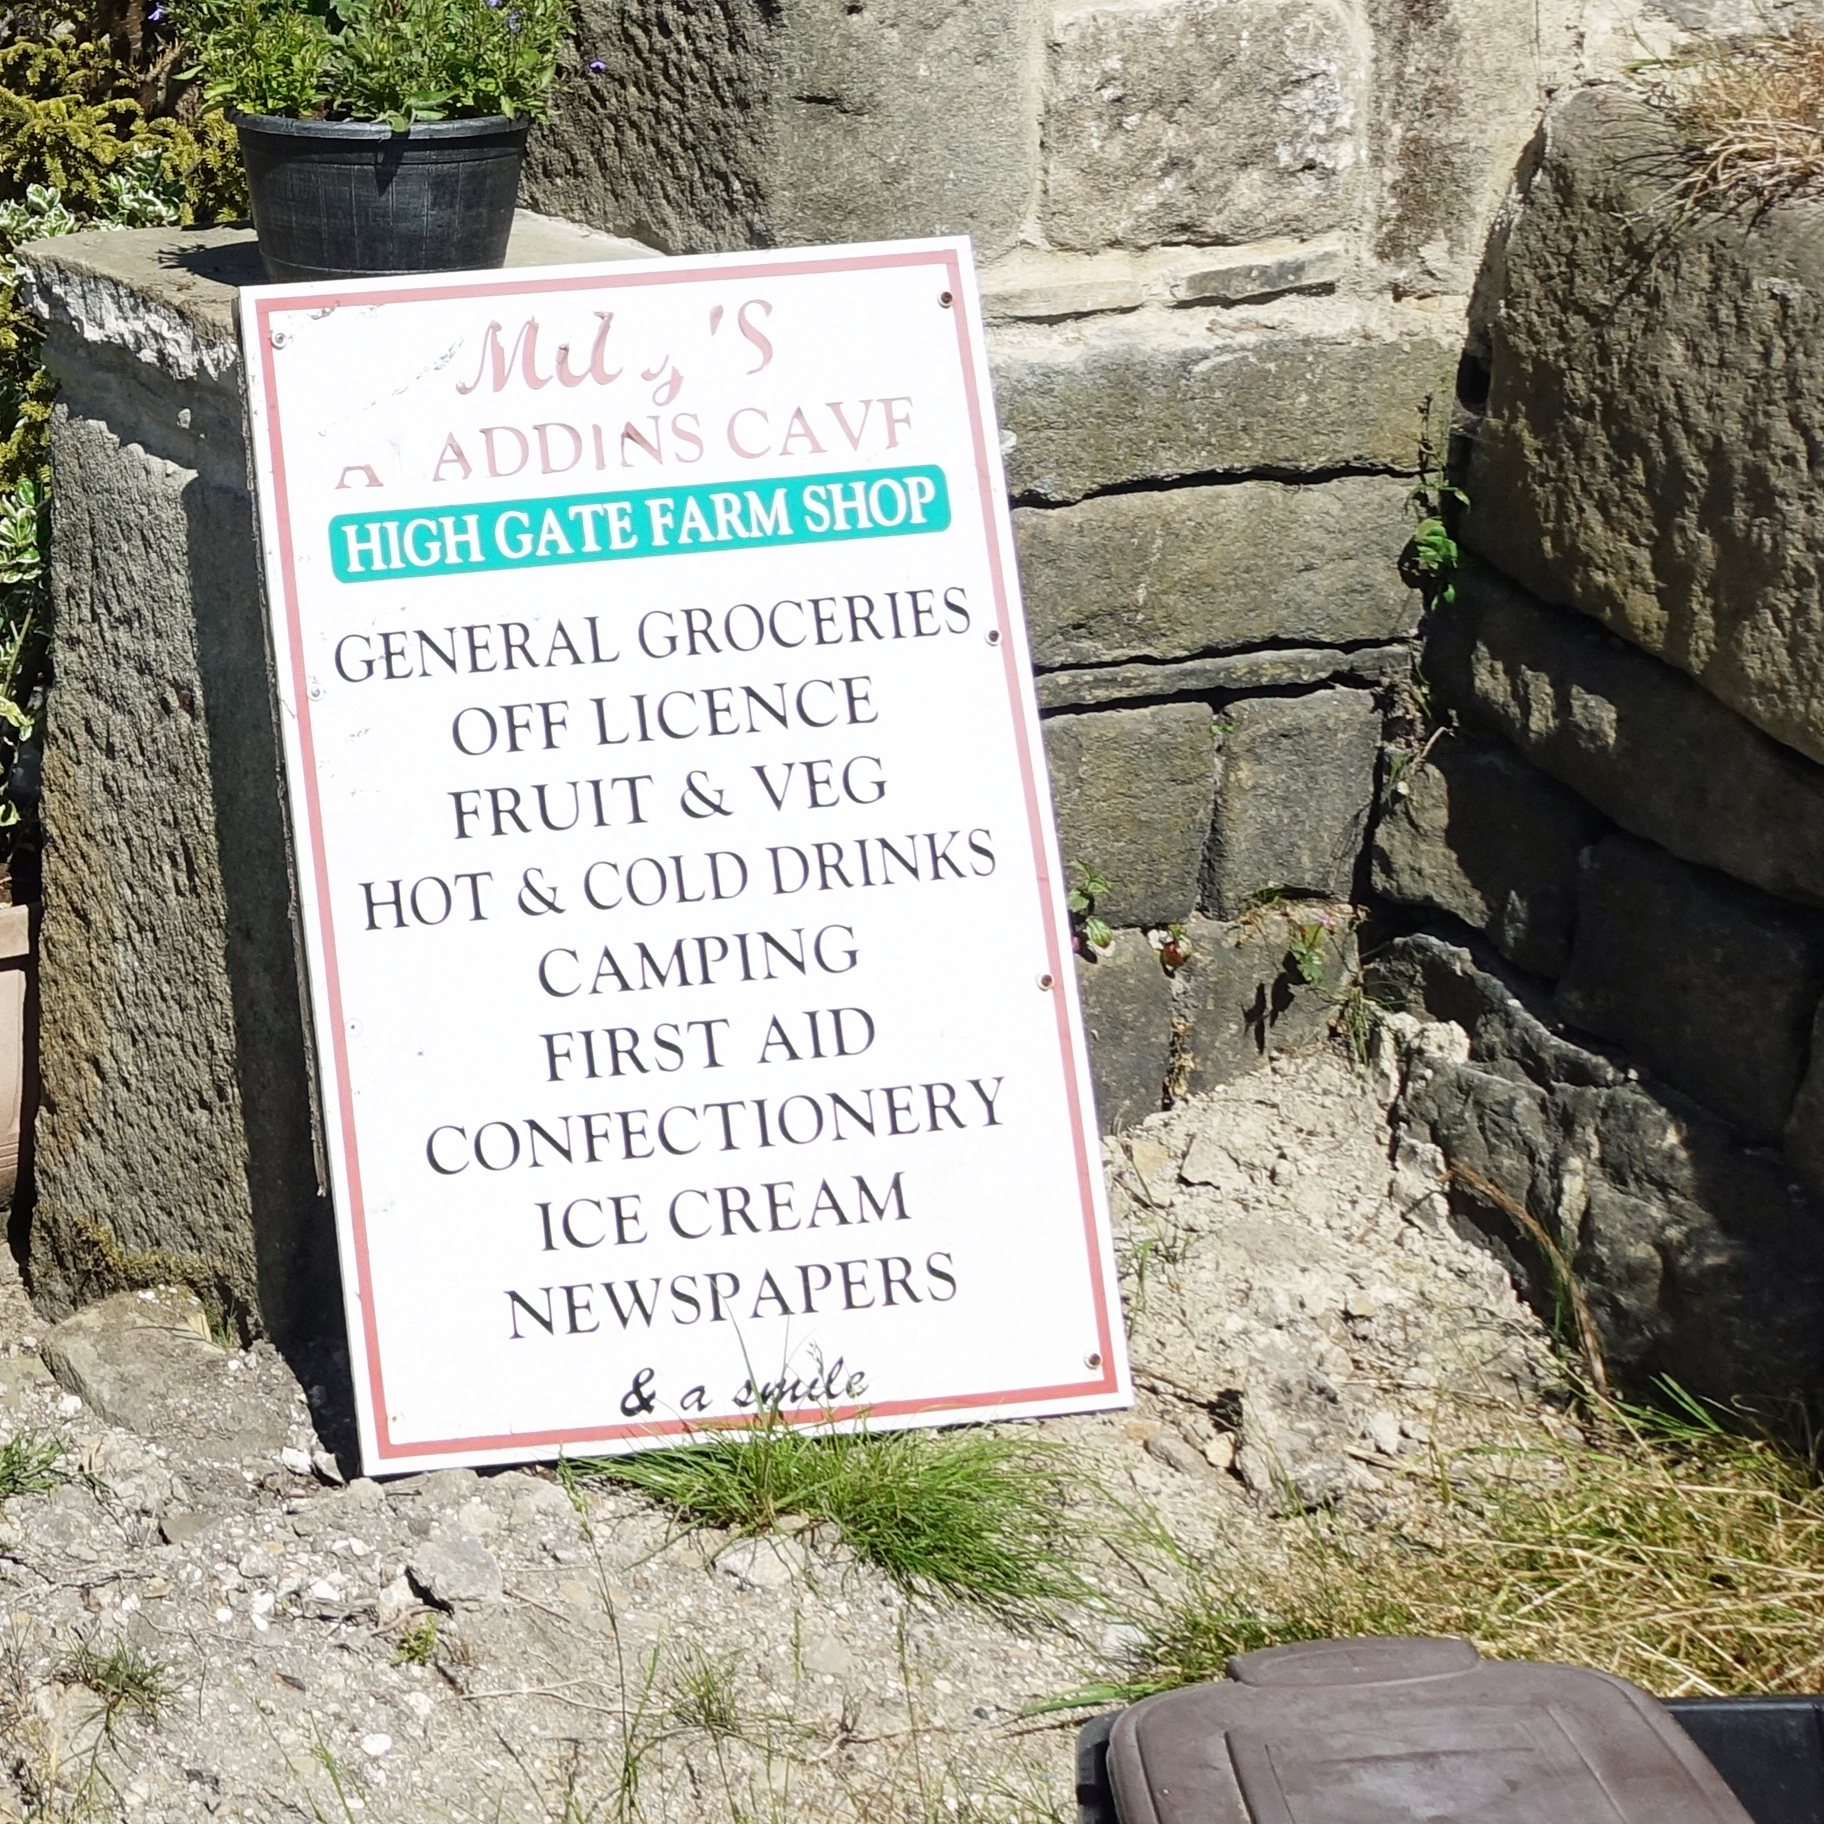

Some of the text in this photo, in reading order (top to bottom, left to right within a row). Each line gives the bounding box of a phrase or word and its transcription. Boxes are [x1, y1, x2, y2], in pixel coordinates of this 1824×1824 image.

[341, 474, 936, 574] HIGH GATE FARM SHOP
[333, 586, 972, 685] GENERAL GROCERIES
[451, 674, 879, 756] OFF LICENCE
[447, 754, 888, 840] FRUIT & VEG
[357, 827, 997, 931] HOT & COLD DRINKS
[537, 924, 860, 998] CAMPING
[539, 1006, 876, 1083] FIRST AID
[425, 1076, 1006, 1176] CONFECTIONERY
[533, 1171, 913, 1252] ICE CREAM
[504, 1251, 958, 1339] NEWSPAPERS
[620, 1355, 870, 1417] & a smile
